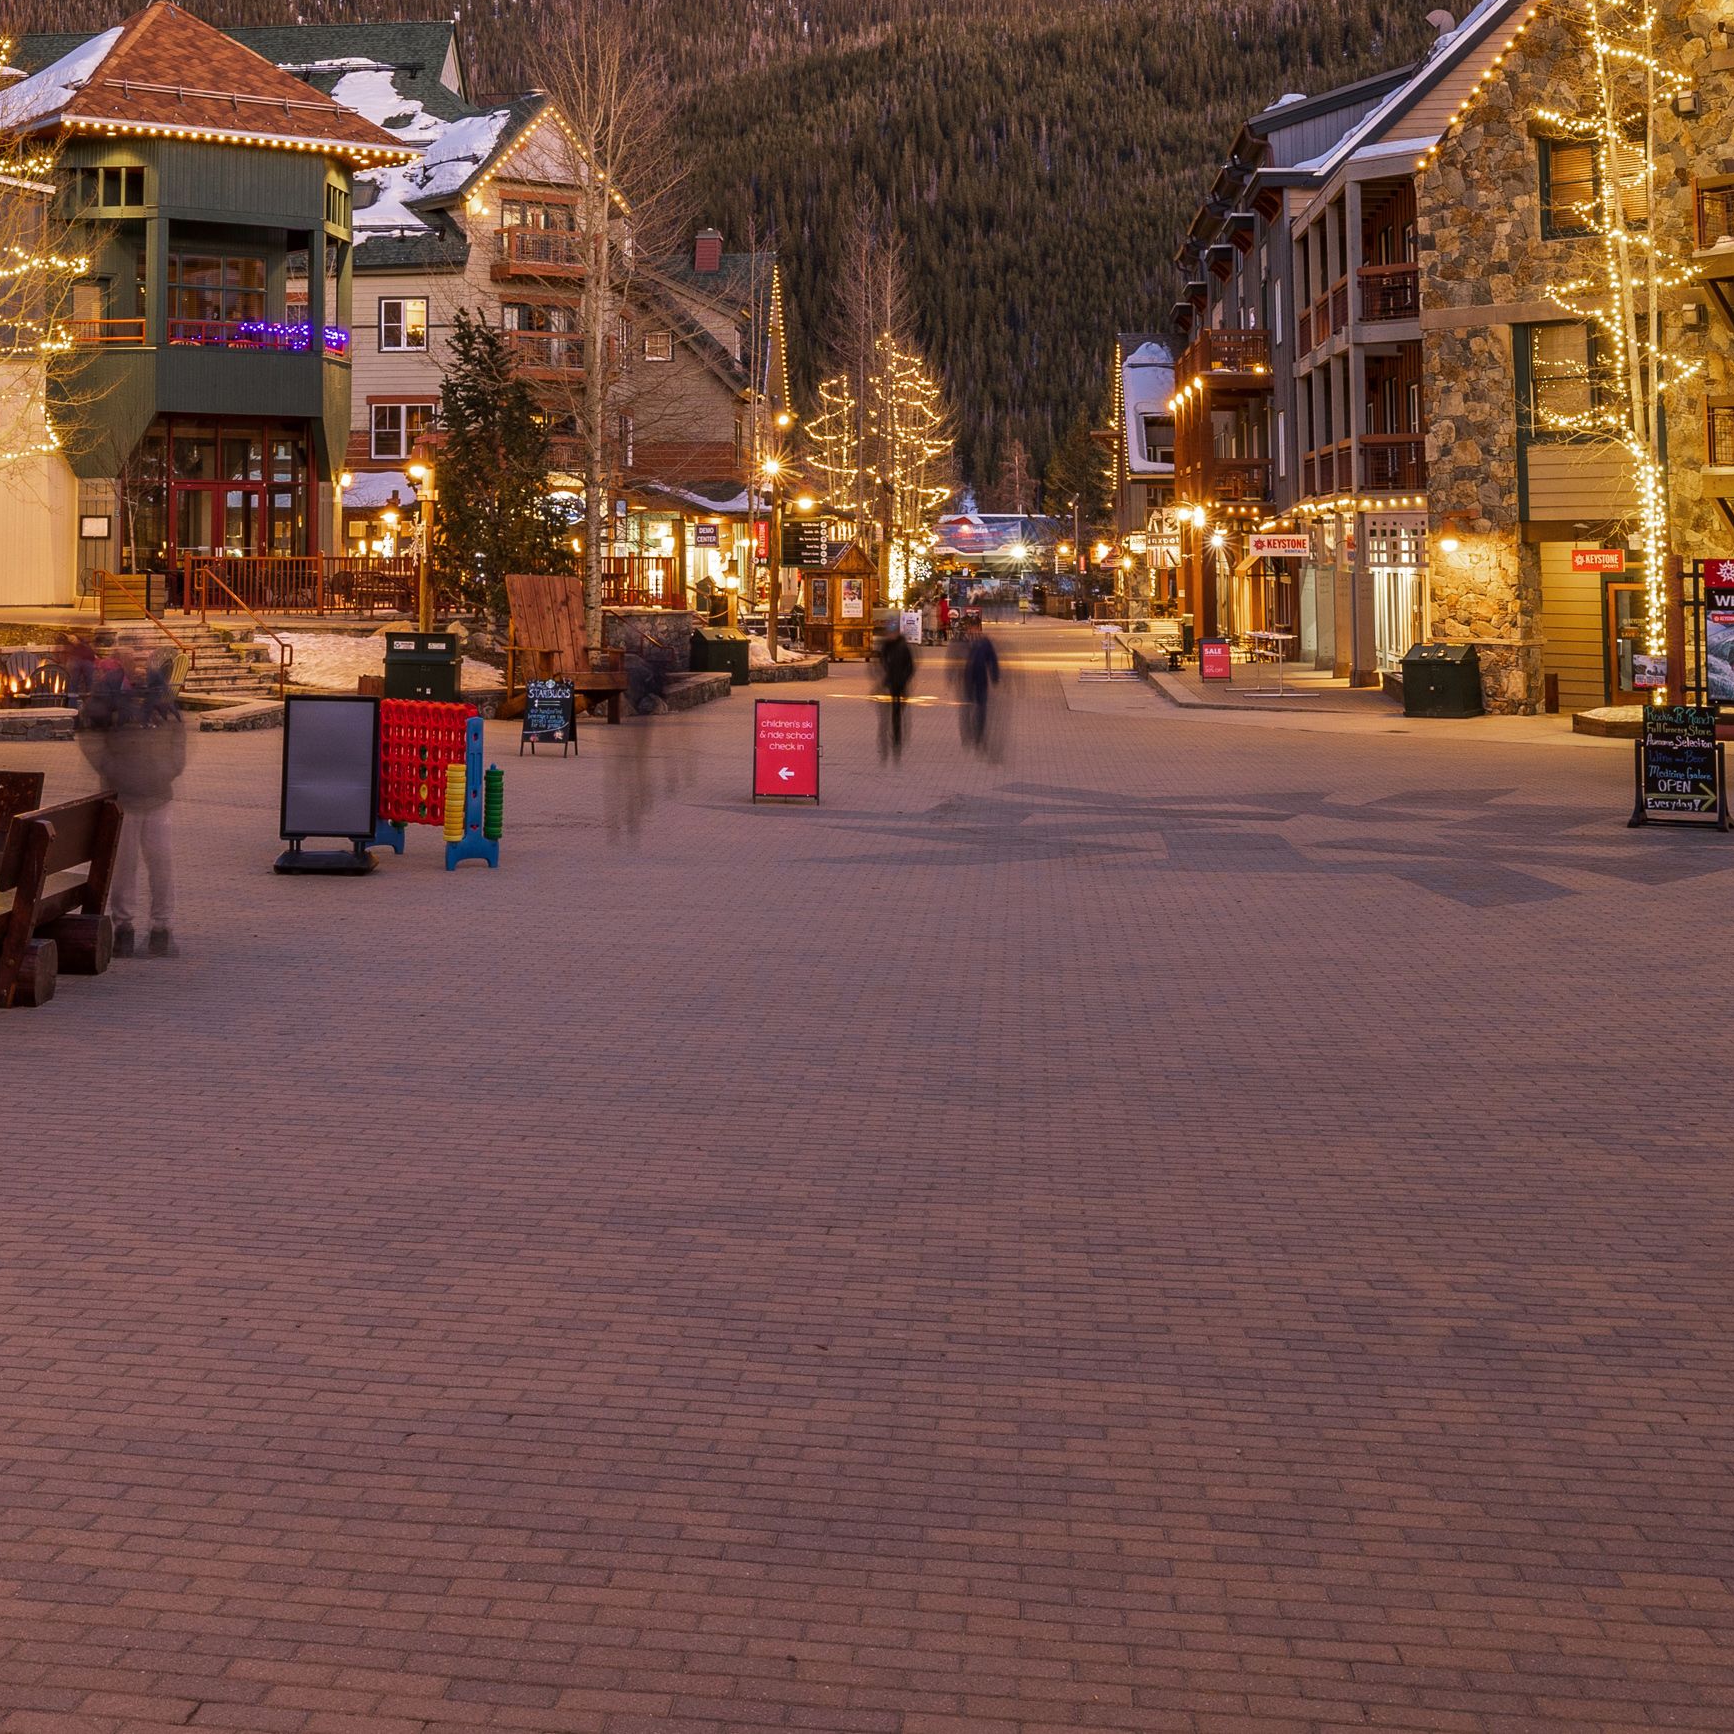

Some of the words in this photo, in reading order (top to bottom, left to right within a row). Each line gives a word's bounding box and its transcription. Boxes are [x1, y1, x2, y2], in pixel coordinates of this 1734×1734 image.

[1148, 535, 1179, 544] inxpot
[1266, 539, 1306, 549] KEYSTONE
[1585, 554, 1619, 564] KEYSTONE
[528, 688, 570, 698] STARBUCKS
[1686, 708, 1715, 725] Ranch
[761, 720, 800, 728] children's
[1646, 722, 1662, 734] Full
[1662, 723, 1688, 736] Grocery
[1688, 725, 1714, 736] Store
[760, 730, 766, 738] &
[768, 731, 784, 739] ride
[769, 742, 796, 750] check
[1675, 735, 1714, 748] Selection
[1649, 765, 1685, 780] Medicine
[1686, 767, 1714, 780] Galore
[1658, 779, 1691, 793] OPEN
